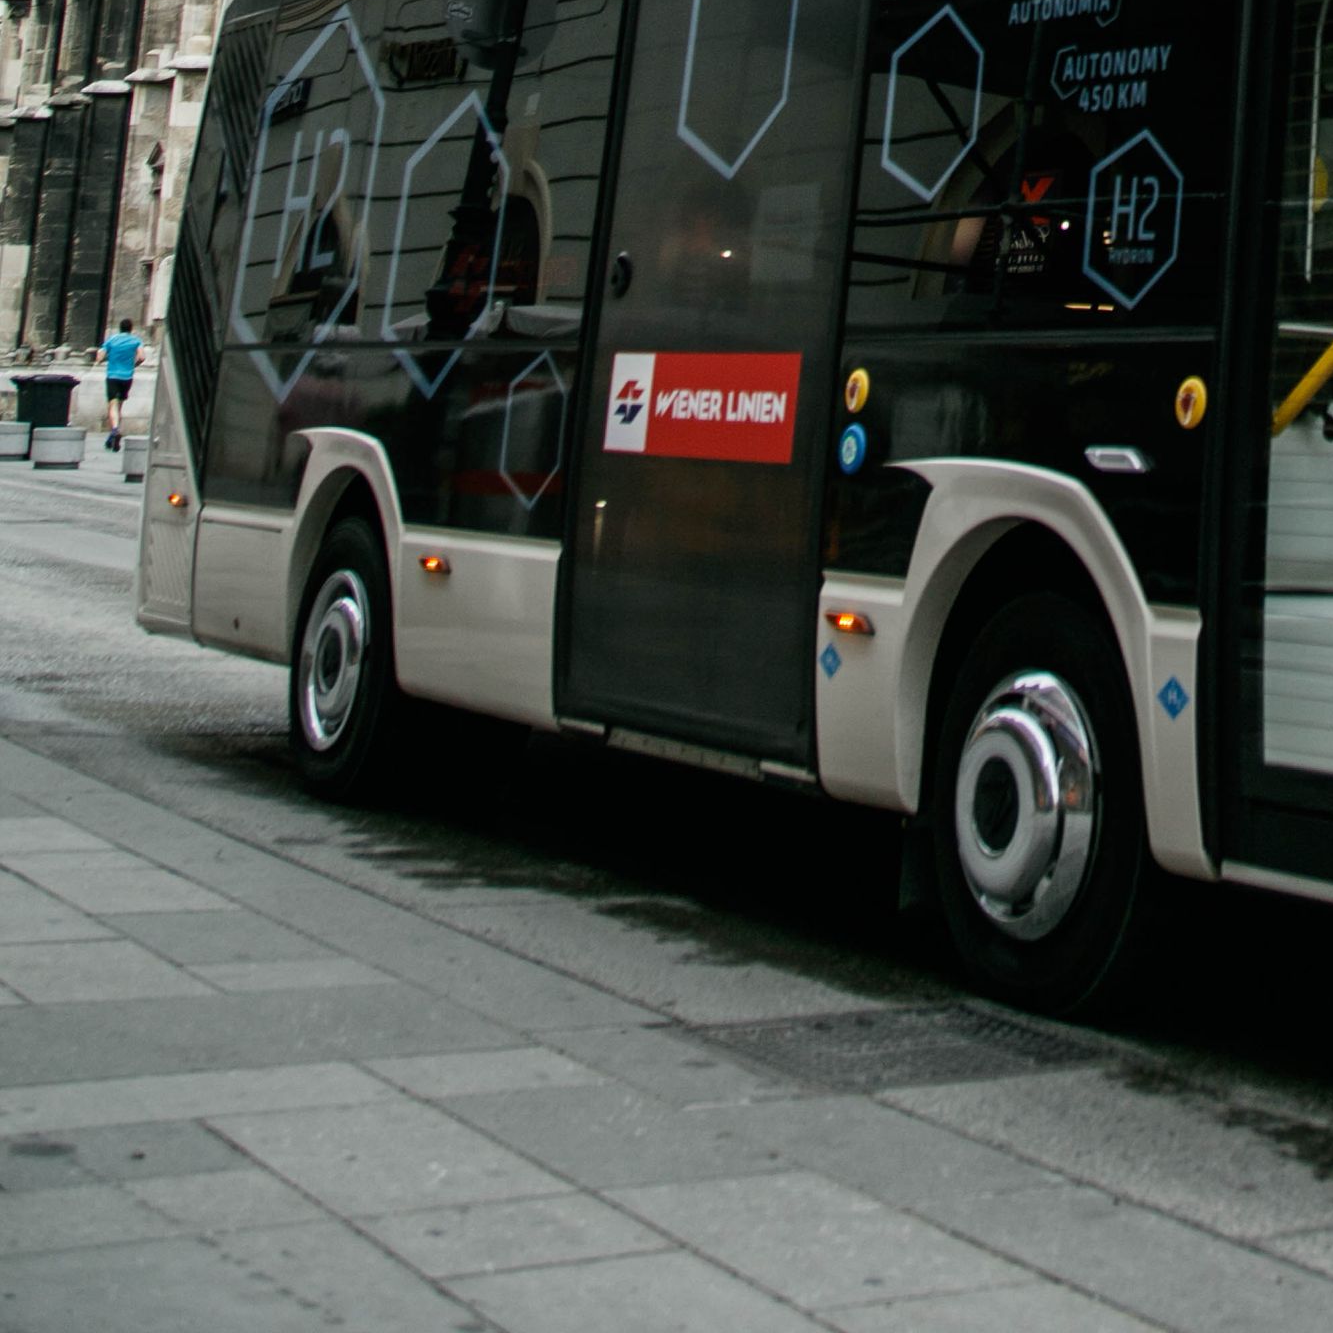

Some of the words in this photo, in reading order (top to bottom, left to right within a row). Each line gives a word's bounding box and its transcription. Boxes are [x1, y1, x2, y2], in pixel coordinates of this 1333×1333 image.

[1061, 43, 1172, 83] AUTONOMY
[1078, 80, 1115, 113] 450
[1116, 79, 1149, 110] KM
[1110, 174, 1161, 242] H2
[655, 388, 721, 422] WIENER
[725, 389, 788, 423] LINIEN
